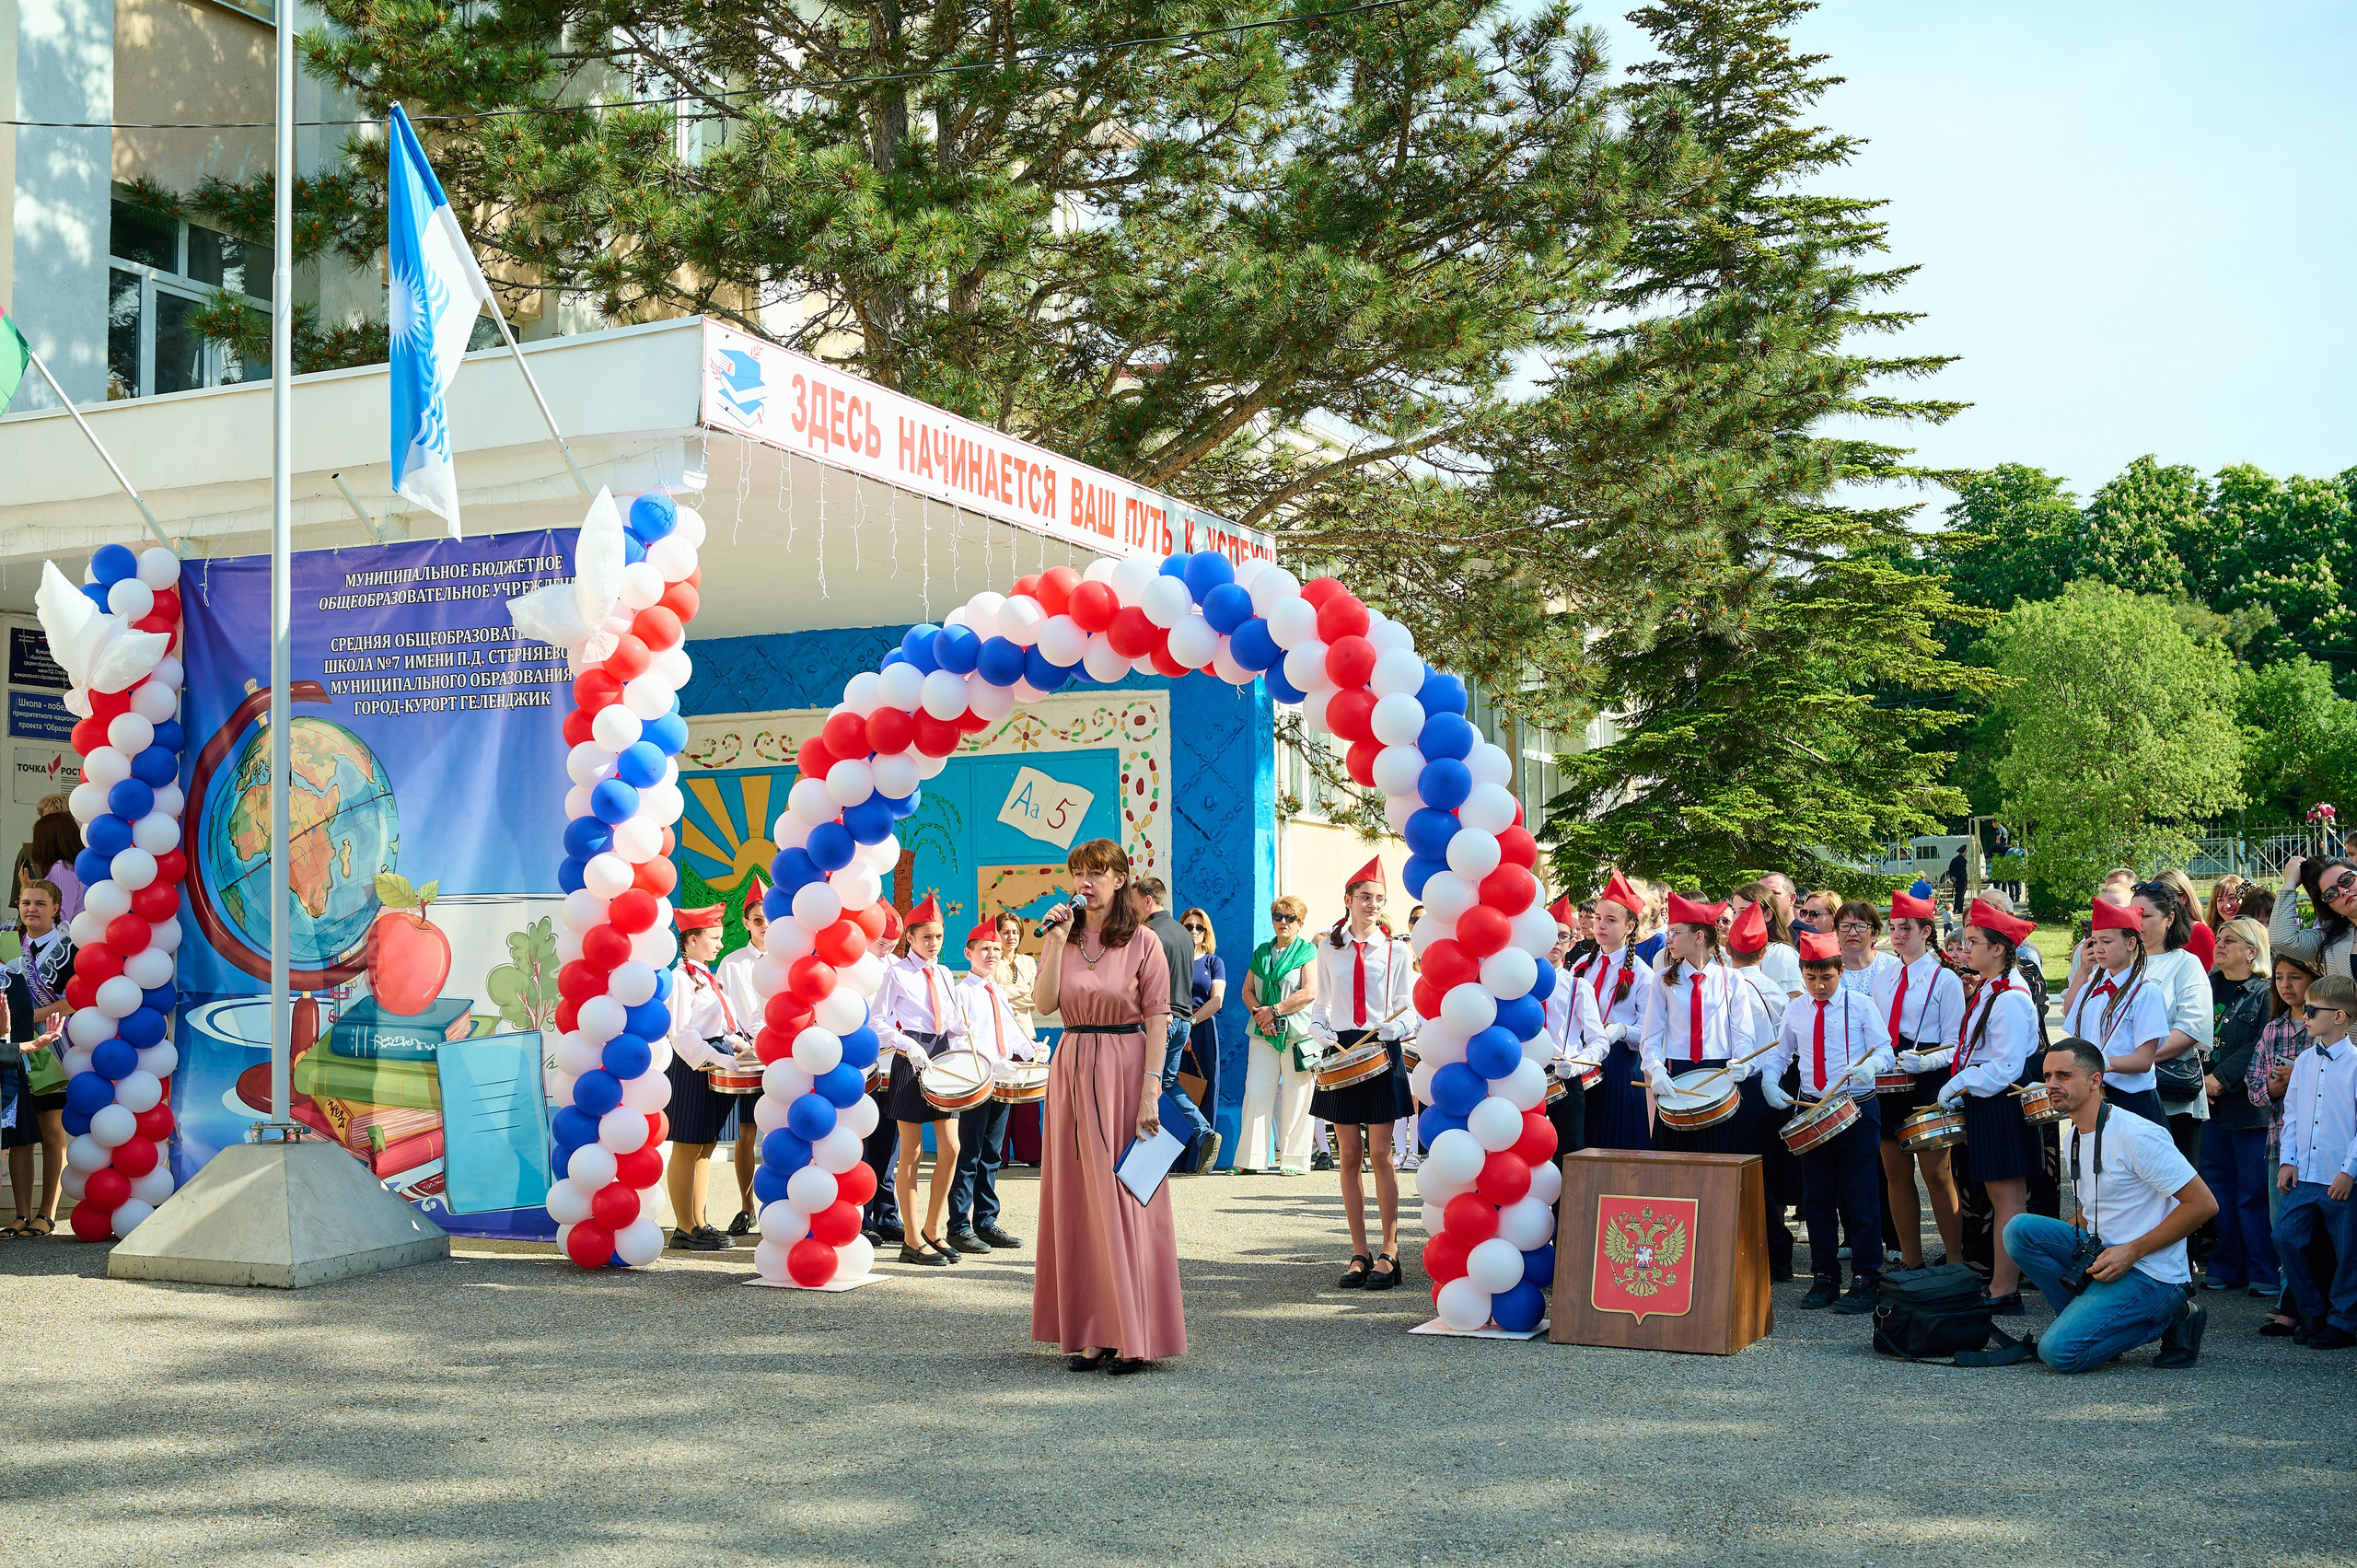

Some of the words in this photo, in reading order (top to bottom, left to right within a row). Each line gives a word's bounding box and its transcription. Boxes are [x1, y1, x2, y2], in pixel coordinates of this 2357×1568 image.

[791, 373, 881, 459] ЗДЕСЬ
[899, 415, 1056, 519] НАЧИНАЕТСЯ
[1071, 476, 1116, 540] ВАШ
[1125, 496, 1172, 556] ПУТЬ
[1185, 518, 1195, 554] К
[344, 563, 469, 588] МУНИЦИПАЛЬНОЕ
[471, 555, 563, 578] БЮДЖЕТНОЕ
[319, 584, 490, 611] ОБЩЕОБРАЗОВАТЕЛЬНОЕ
[331, 634, 391, 654] СРЕДНЯЯ
[394, 626, 528, 649] ОБЩЕОБРАЗОВАТ
[324, 657, 373, 674] ШКОЛА
[377, 656, 401, 671] №7
[404, 652, 454, 669] ИМЕНИ
[457, 650, 485, 668] П.Д.
[488, 645, 568, 664] СТЕРНЯЕВО
[330, 674, 467, 695] МУНИЦИПАЛЬНОГО
[470, 667, 573, 687] ОБРАЗОВАНИЯ
[12, 710, 53, 719] приоритетного
[18, 697, 42, 708] Школа
[354, 695, 457, 716] ГОРОД-КУРОРТ
[460, 691, 552, 711] ГЕЛЕНДЖИК
[18, 721, 42, 730] проекта
[43, 723, 74, 733] "Образов
[17, 763, 47, 773] ТОЧКА
[1047, 797, 1077, 830] 5
